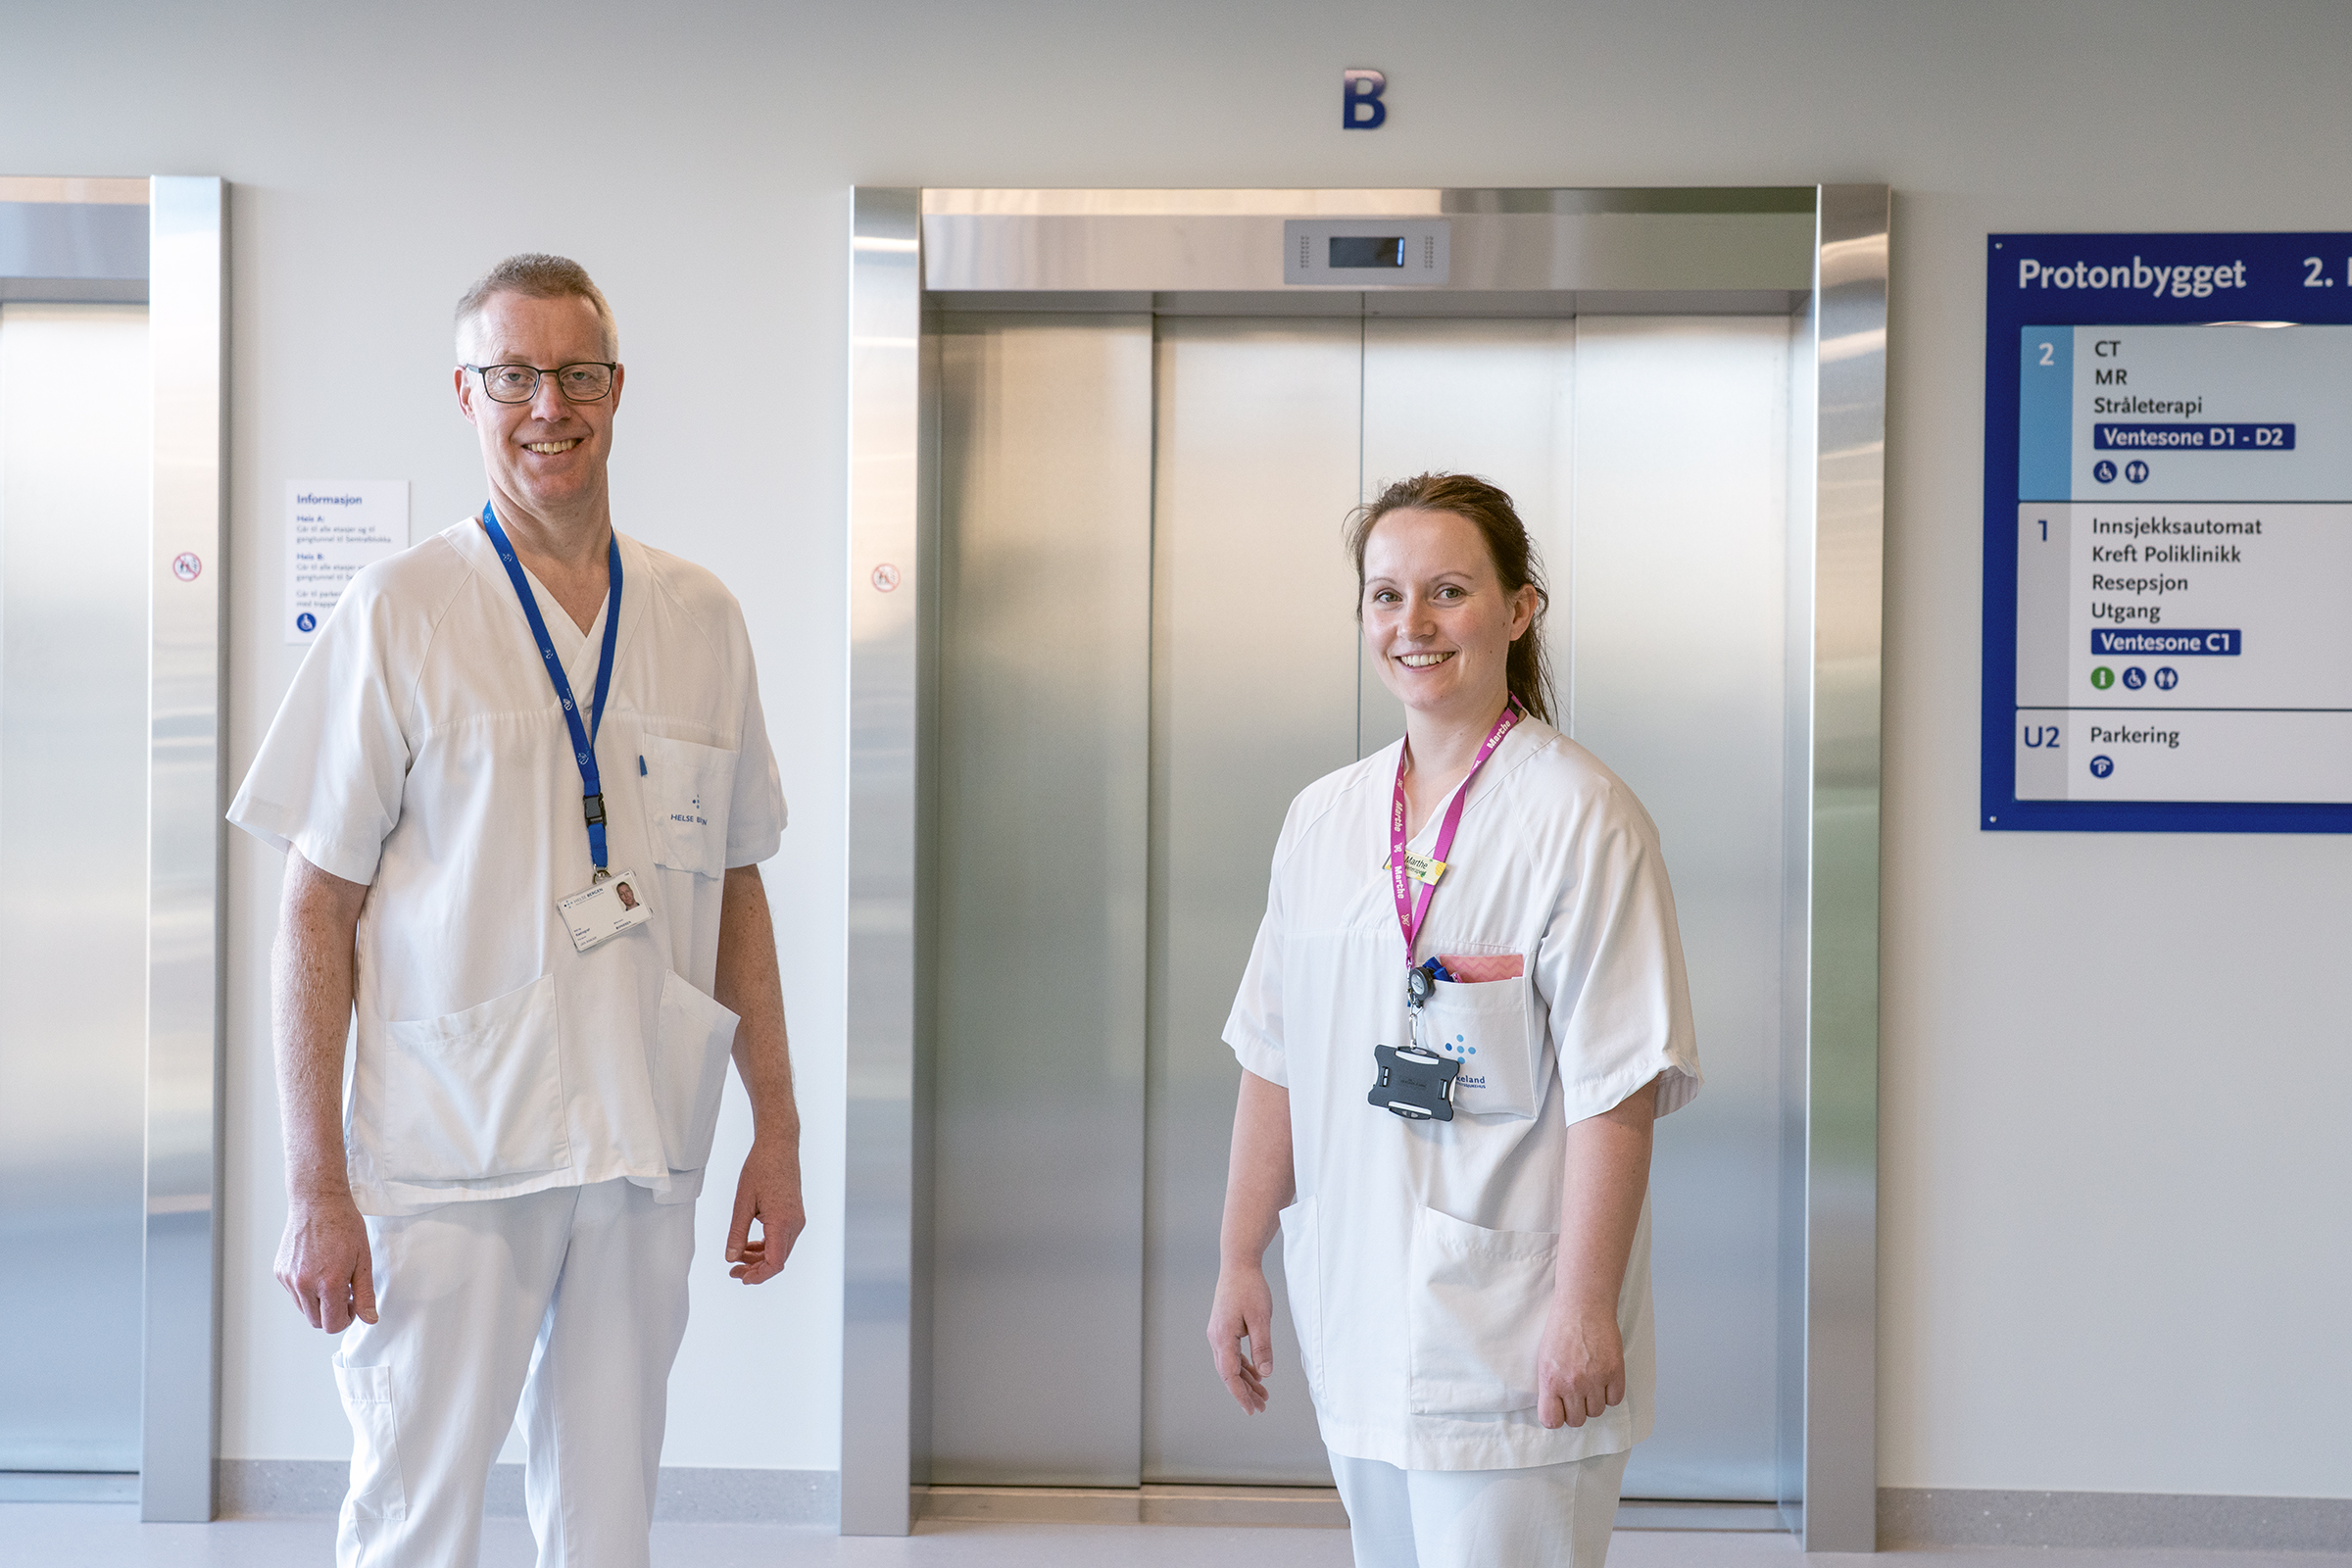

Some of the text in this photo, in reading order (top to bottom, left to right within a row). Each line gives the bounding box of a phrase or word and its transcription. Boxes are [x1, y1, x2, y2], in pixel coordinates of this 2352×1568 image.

[1343, 69, 1386, 129] B
[2019, 256, 2247, 298] Protonbygget
[2303, 256, 2334, 288] 2.
[2038, 343, 2054, 366] 2
[2094, 341, 2121, 357] CT
[2095, 368, 2128, 385] MR
[2093, 396, 2203, 418] Stråleterapi
[2103, 428, 2204, 447] Ventesone
[2210, 428, 2235, 446] D1
[2255, 428, 2283, 446] D2
[297, 494, 363, 507] Informasjon
[2037, 519, 2048, 541] 1
[2093, 517, 2262, 538] Innsjekksautomat
[2093, 545, 2241, 563] Kreft Poliklinikk
[2093, 574, 2188, 596] Resepsjon
[2091, 603, 2161, 623] Utgang
[2100, 633, 2230, 652] Ventesone C1
[1486, 720, 1511, 750] Marthe
[2024, 726, 2060, 749] U2
[2090, 727, 2180, 749] Parkering
[670, 813, 694, 823] HELSE
[1394, 800, 1403, 833] Marthe
[1405, 856, 1429, 869] Marthe
[1394, 865, 1404, 900] Marthe
